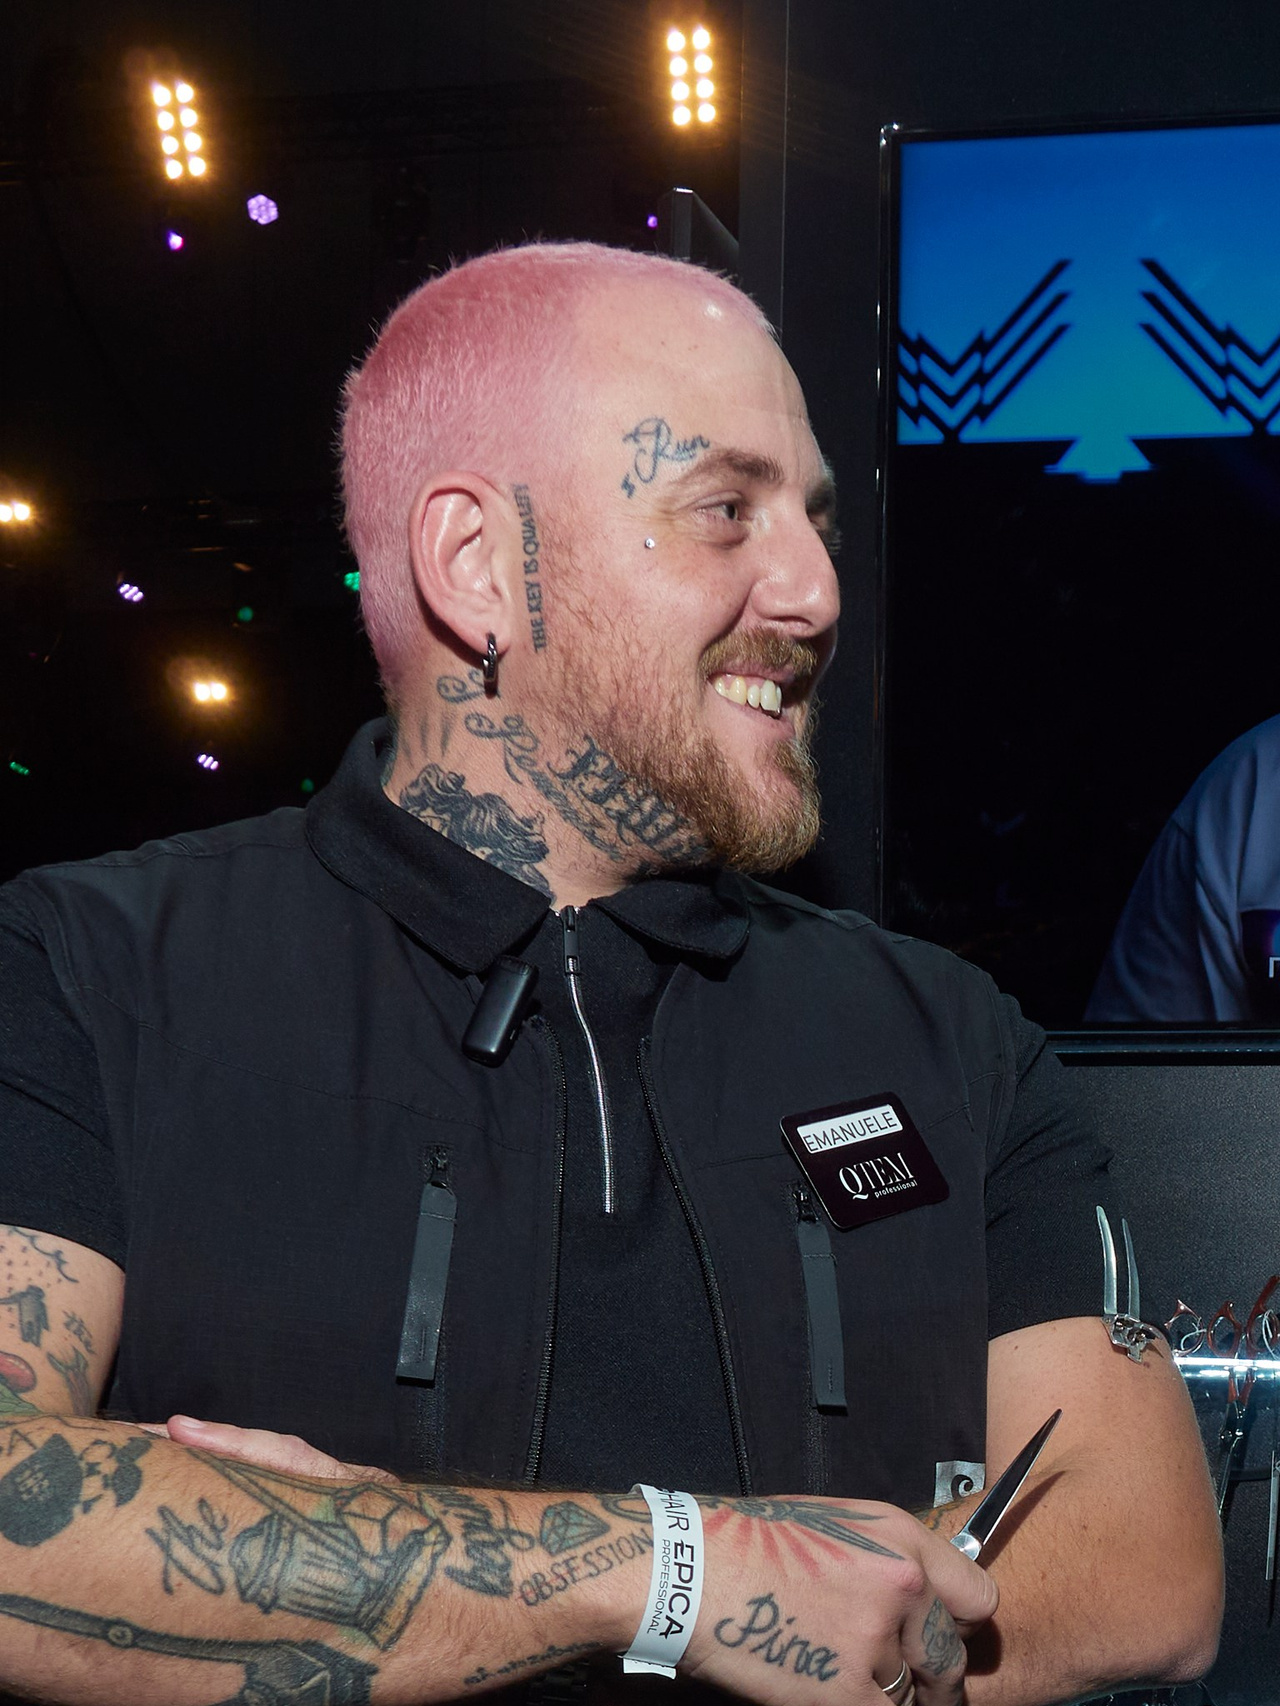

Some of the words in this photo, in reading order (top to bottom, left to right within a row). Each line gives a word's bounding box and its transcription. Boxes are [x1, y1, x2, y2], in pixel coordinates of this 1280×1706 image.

[523, 558, 539, 575] IS
[524, 580, 543, 614] KEY
[530, 617, 548, 653] THE
[802, 1111, 898, 1153] EMANUELE
[874, 1180, 918, 1198] professional
[656, 1491, 690, 1532] HAIR
[646, 1538, 671, 1635] PROFESSIONAL
[658, 1538, 695, 1640] EPICA
